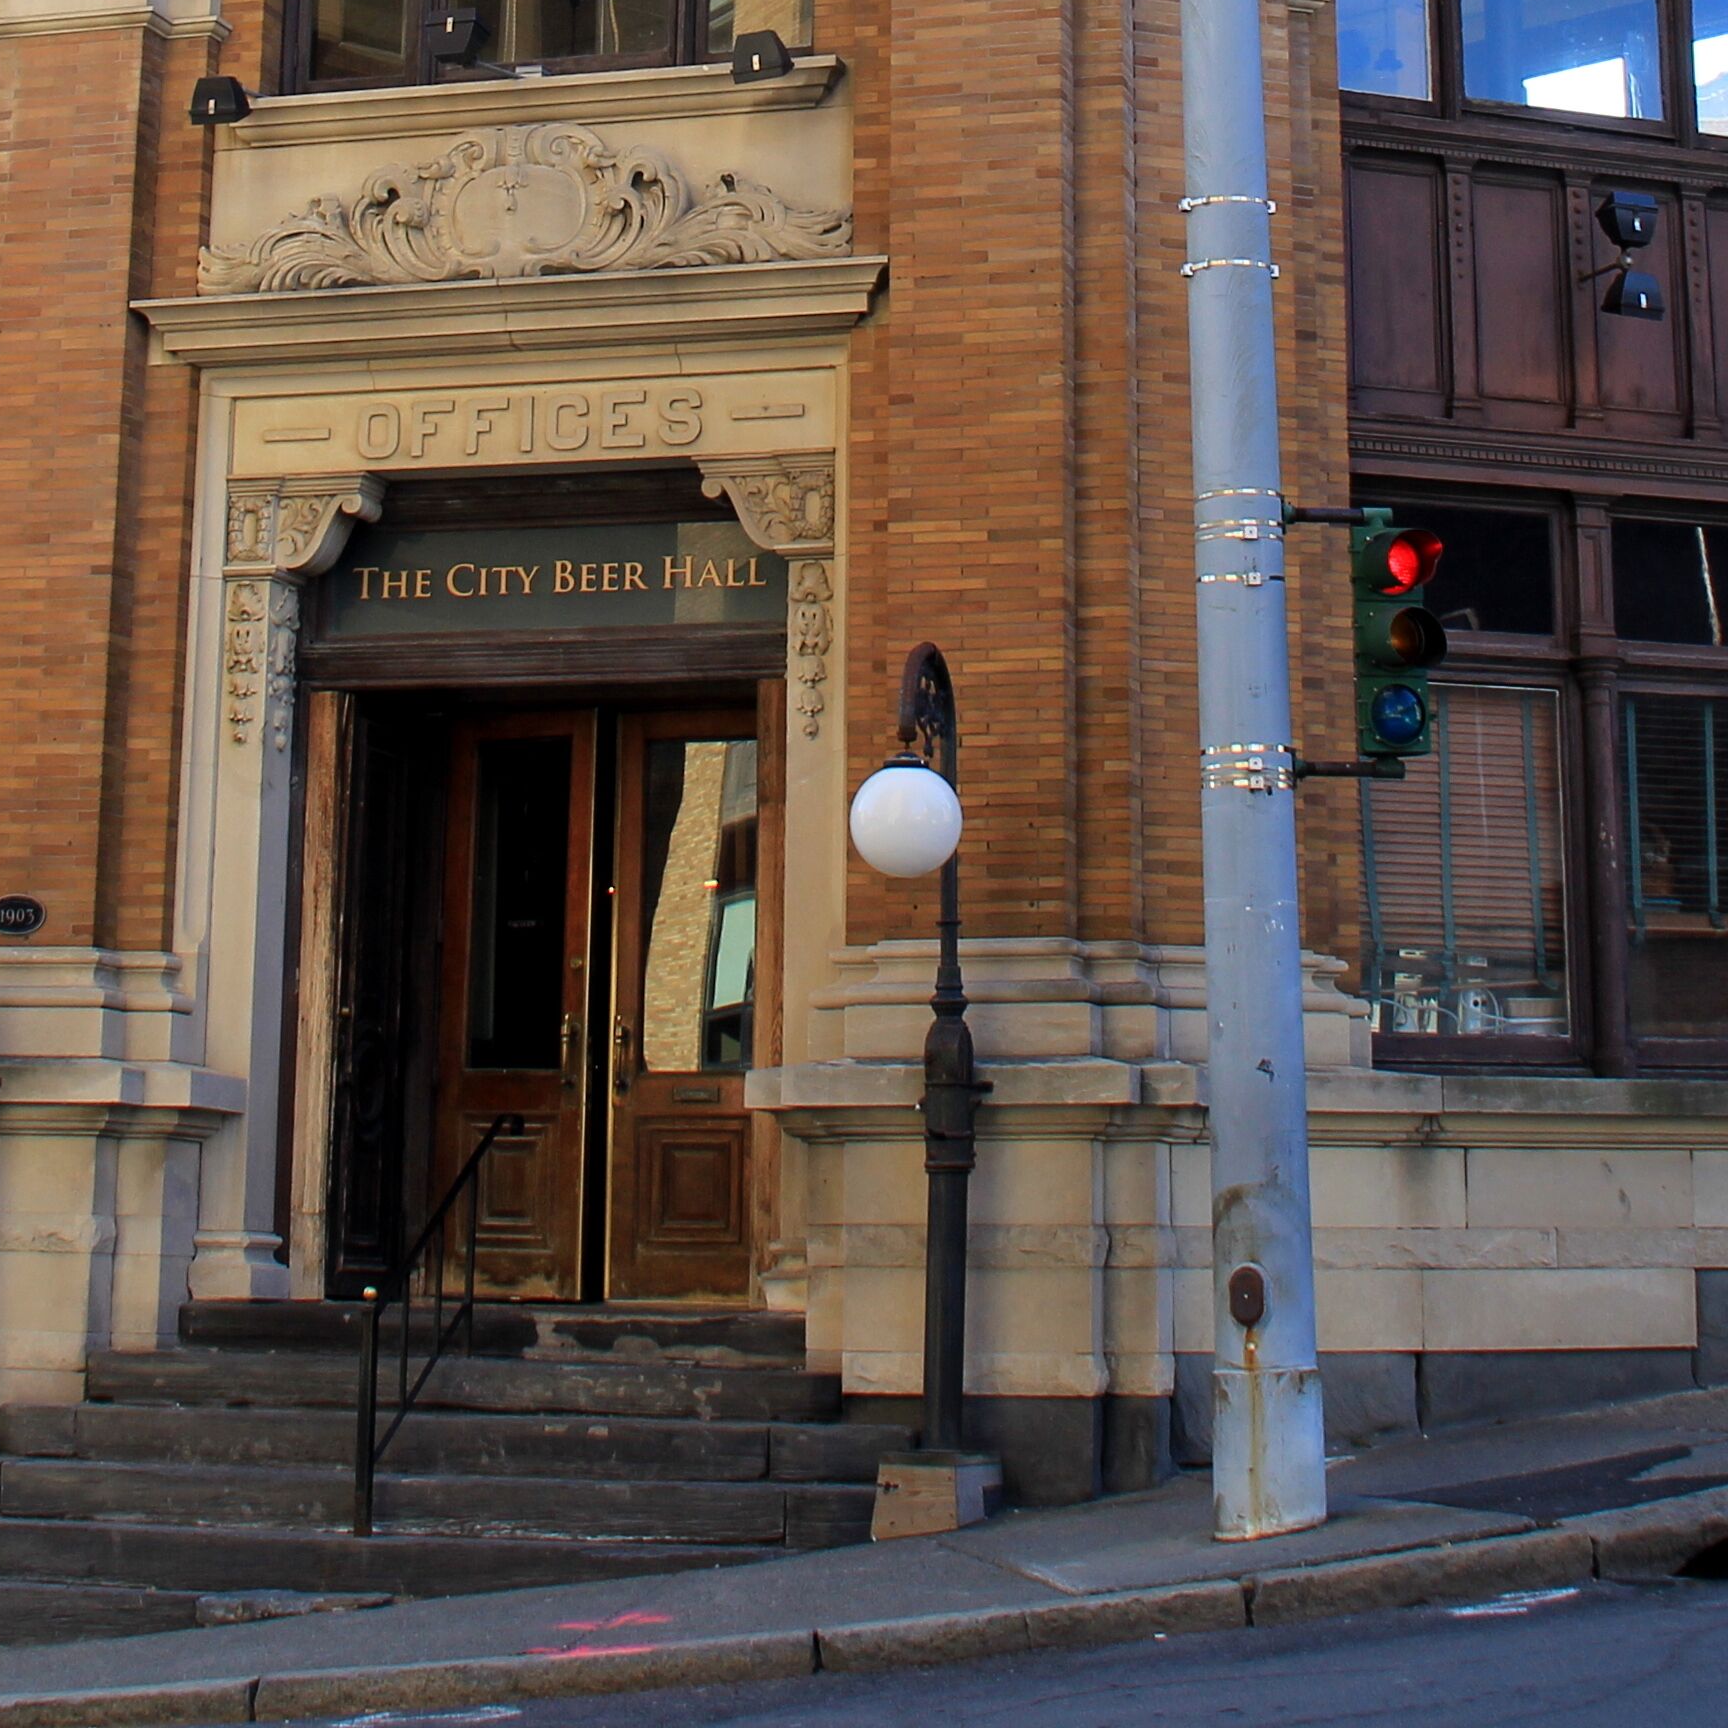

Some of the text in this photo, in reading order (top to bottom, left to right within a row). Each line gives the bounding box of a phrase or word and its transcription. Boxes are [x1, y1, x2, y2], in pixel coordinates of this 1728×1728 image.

[357, 386, 703, 460] OFFICES
[352, 554, 768, 601] THE CITY BEER HALL
[0, 908, 35, 925] 1903
